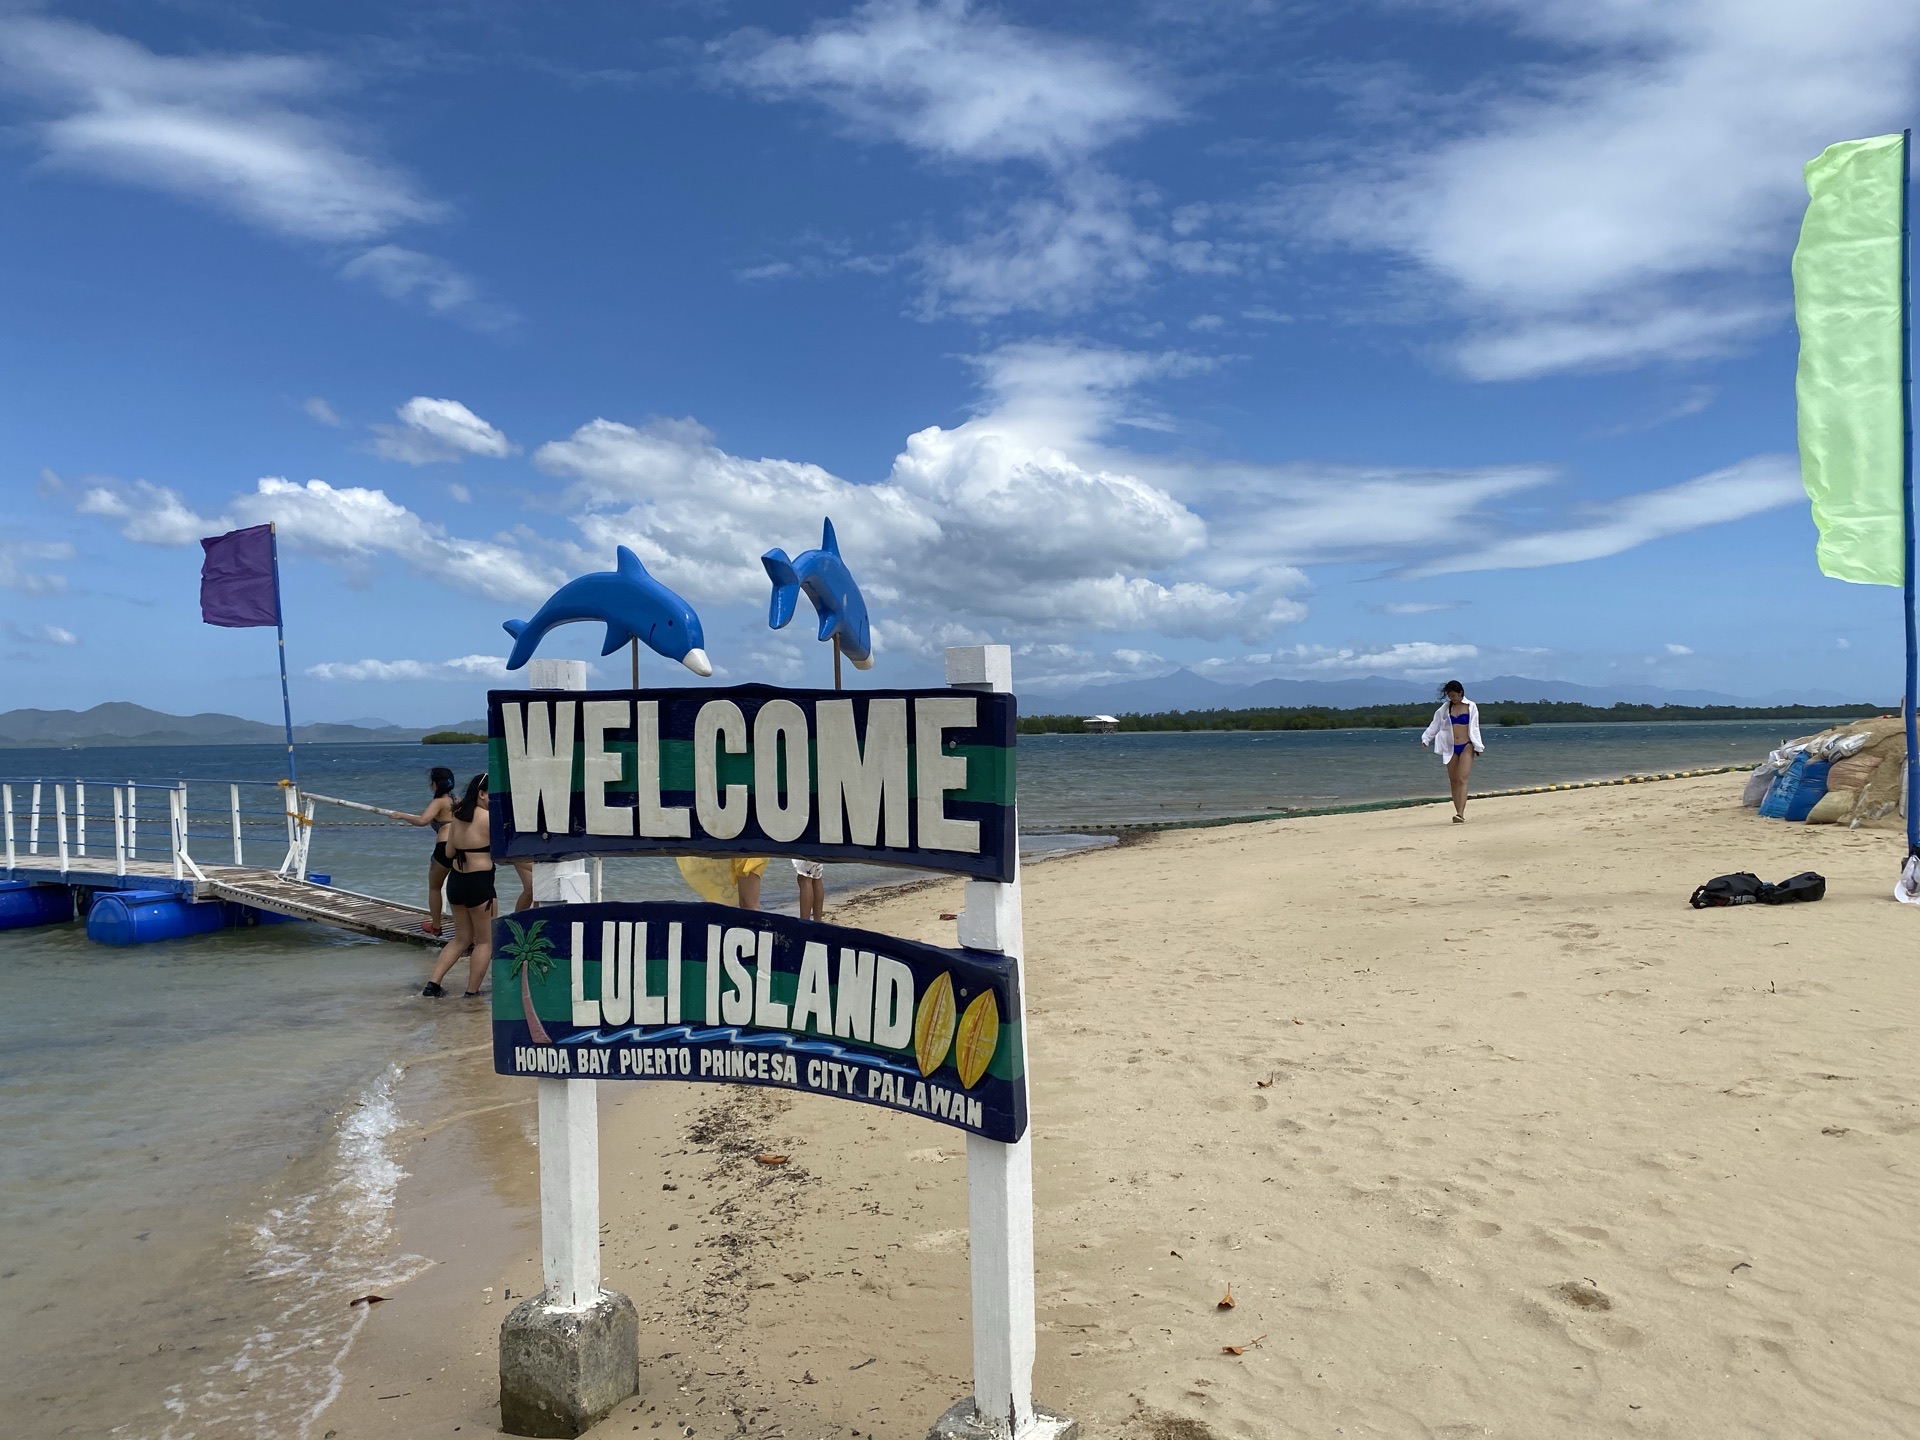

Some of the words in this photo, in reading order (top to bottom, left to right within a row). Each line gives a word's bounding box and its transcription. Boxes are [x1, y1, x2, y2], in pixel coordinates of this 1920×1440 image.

[501, 697, 981, 854] WELCOME
[571, 921, 682, 1028] LULI
[706, 924, 915, 1050] ISLAND
[514, 1046, 571, 1074] HONDA
[577, 1048, 612, 1075] BAY
[619, 1047, 692, 1076] PUERTO
[700, 1048, 798, 1084] PRINCESA
[807, 1059, 860, 1089] CITY
[868, 1070, 983, 1129] PALAWAN
